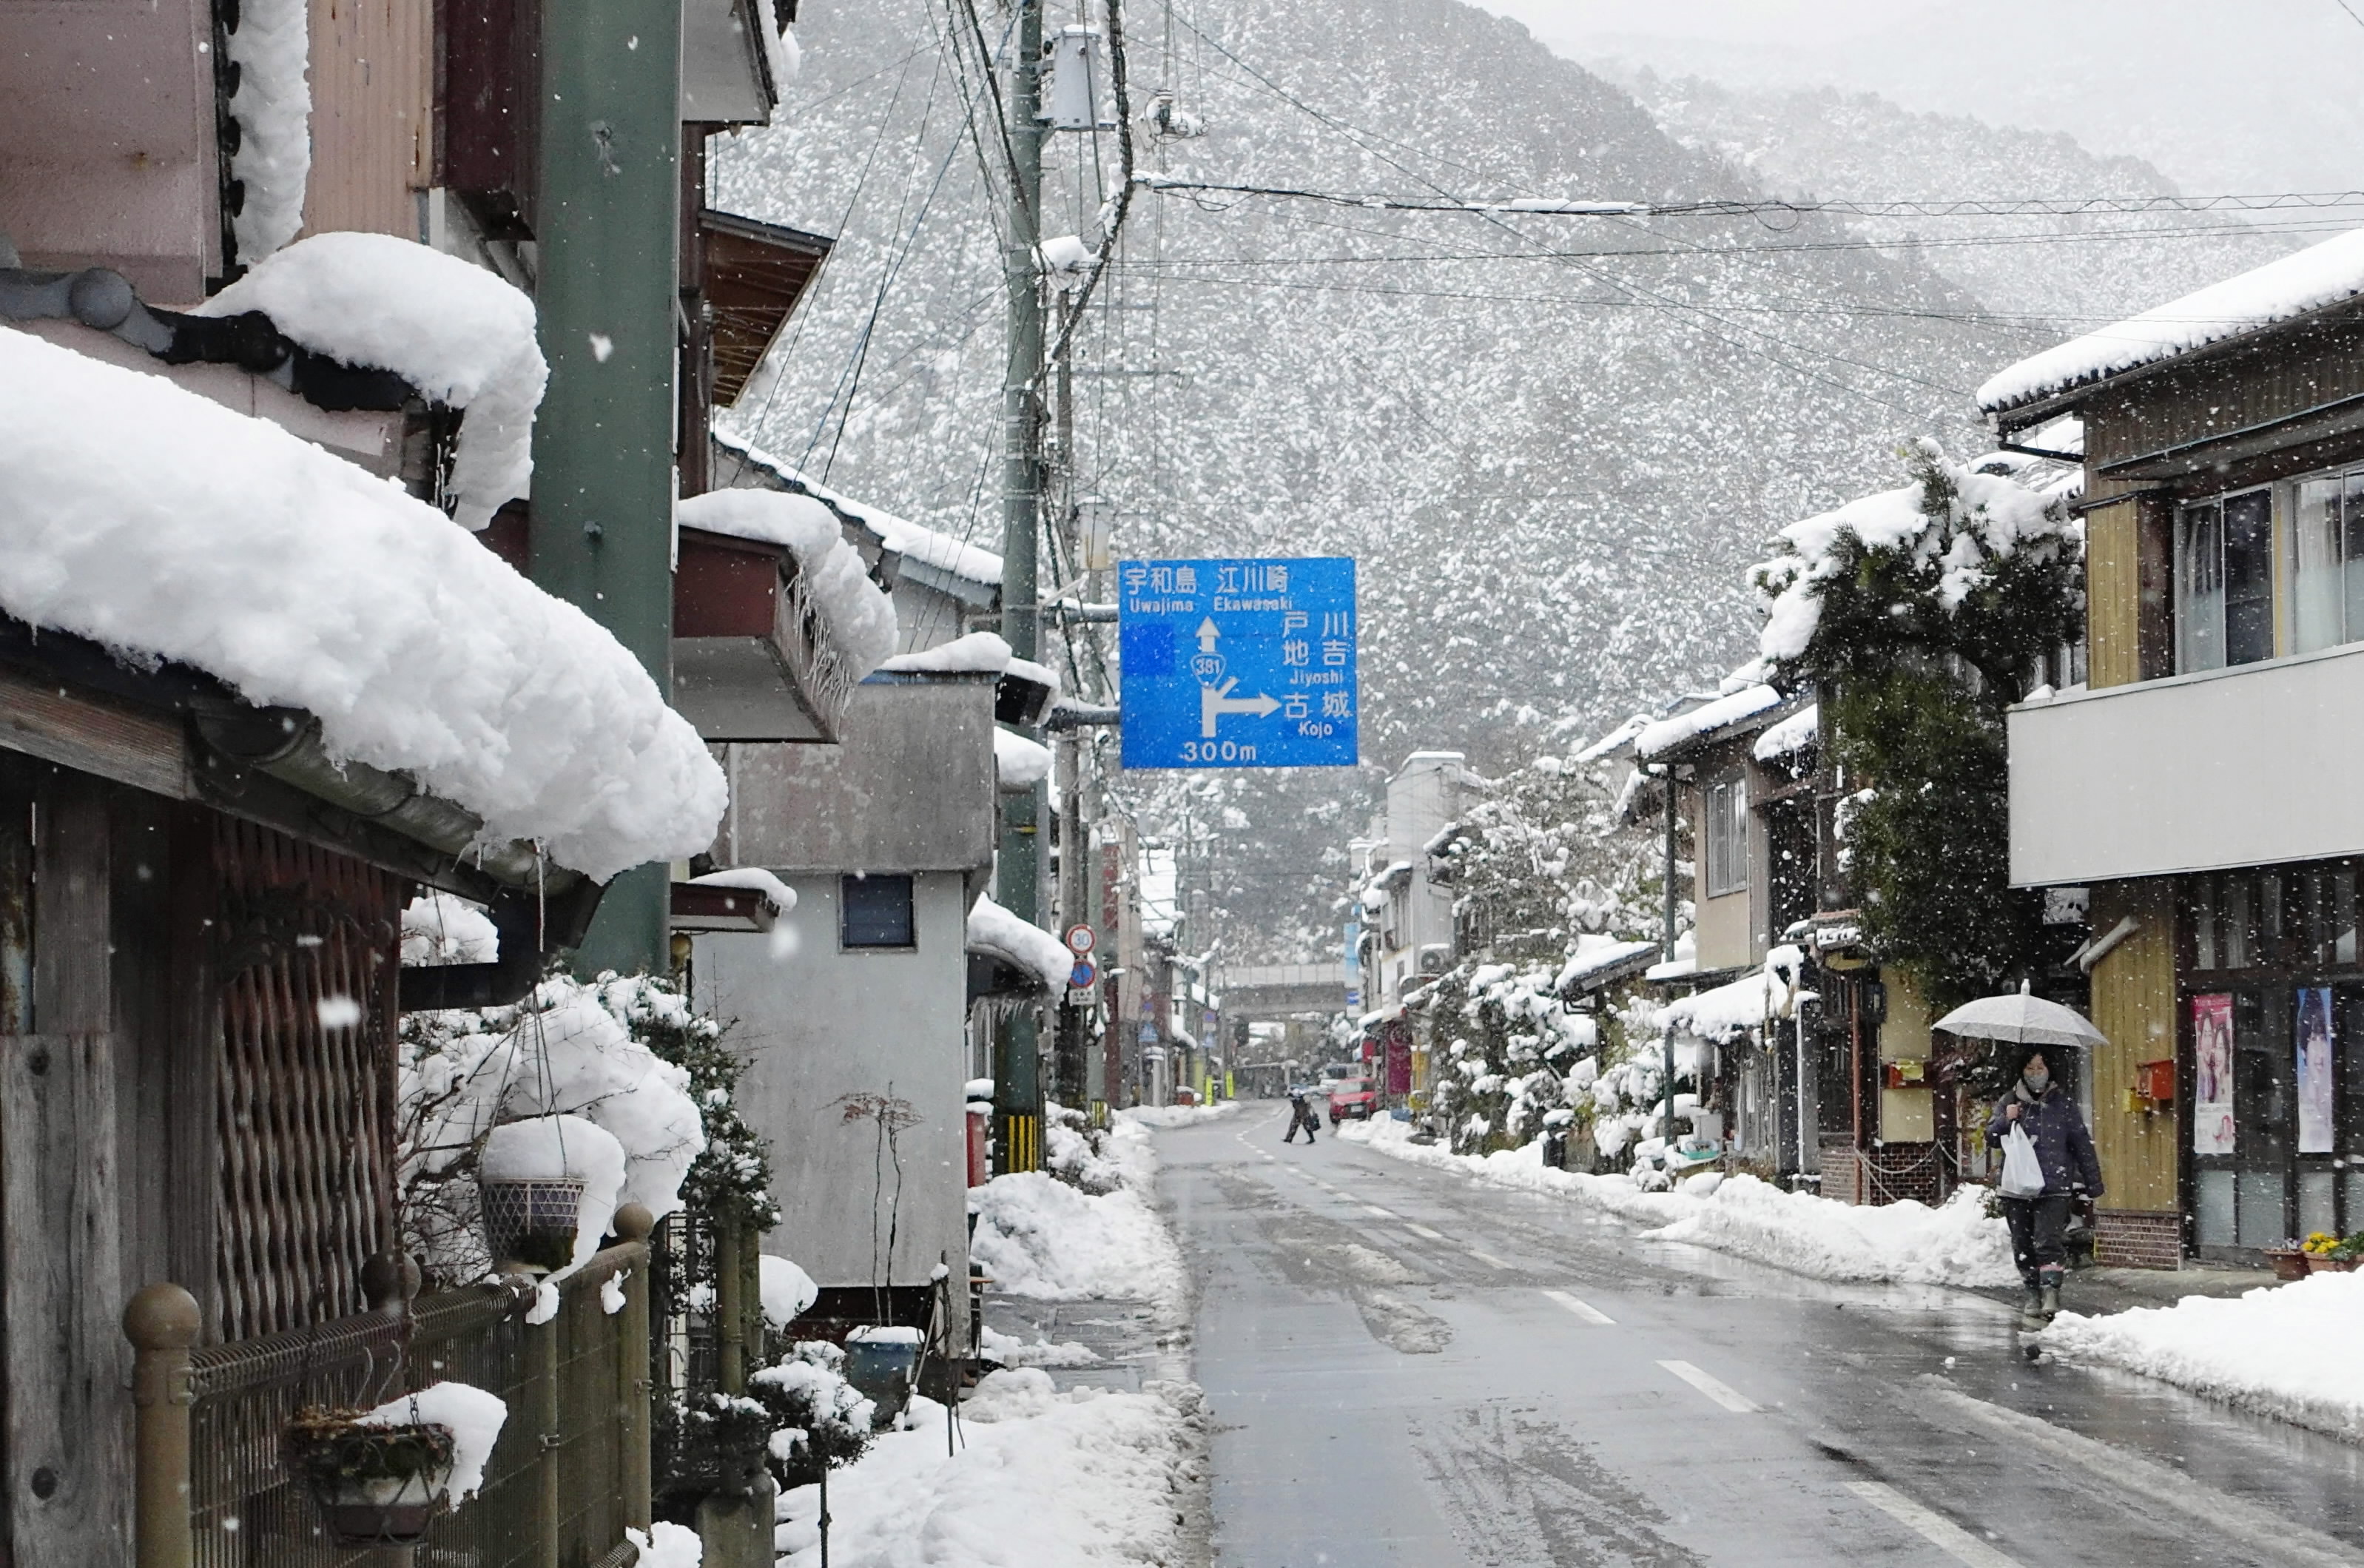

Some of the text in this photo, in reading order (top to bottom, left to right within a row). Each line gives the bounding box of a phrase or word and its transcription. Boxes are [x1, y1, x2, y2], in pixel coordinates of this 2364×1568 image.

[1125, 566, 1197, 595] 宇和島
[1216, 565, 1289, 594] 江川崎
[1130, 599, 1194, 616] Uwajima
[1213, 596, 1293, 612] Ekawasaki
[1282, 639, 1347, 666] 地吉
[1196, 658, 1221, 675] 381
[1290, 670, 1344, 687] Jiyoshi
[1284, 691, 1351, 719] 古城
[1298, 721, 1333, 738] Kojo
[1183, 741, 1257, 761] 300m
[1074, 933, 1090, 946] 30
